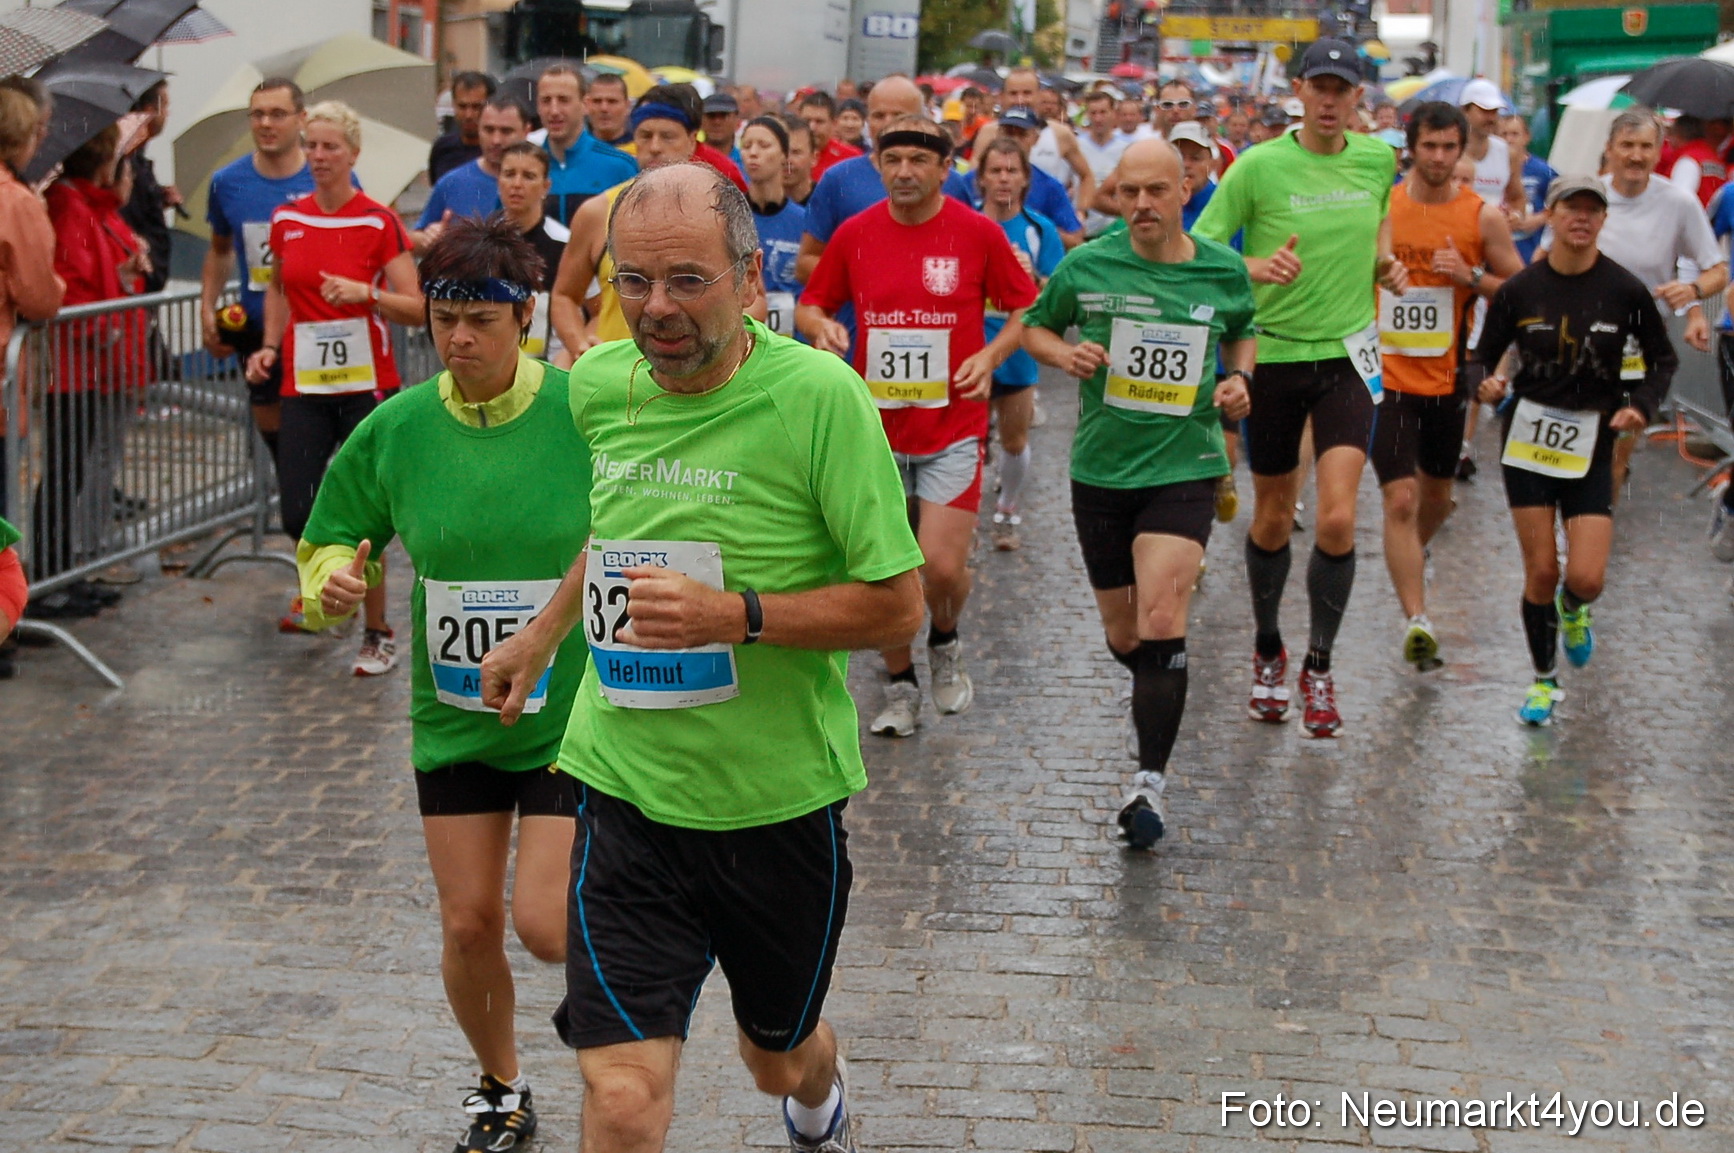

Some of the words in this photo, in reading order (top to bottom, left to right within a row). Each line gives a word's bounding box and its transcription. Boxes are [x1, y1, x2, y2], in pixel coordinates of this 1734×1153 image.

[863, 309, 958, 326] Stadt-Team
[1392, 305, 1438, 330] 899
[316, 340, 348, 367] 79
[880, 351, 929, 379] 311
[1127, 345, 1189, 382] 383
[887, 386, 923, 399] Charly
[1128, 384, 1179, 404] Rüdiger
[1530, 418, 1580, 452] 162
[642, 488, 693, 501] WOHNEN.
[697, 494, 736, 505] LEBEN.
[603, 551, 668, 567] BOCK
[462, 590, 520, 603] BOCK
[438, 615, 538, 665] 205
[608, 659, 685, 684] Helmut
